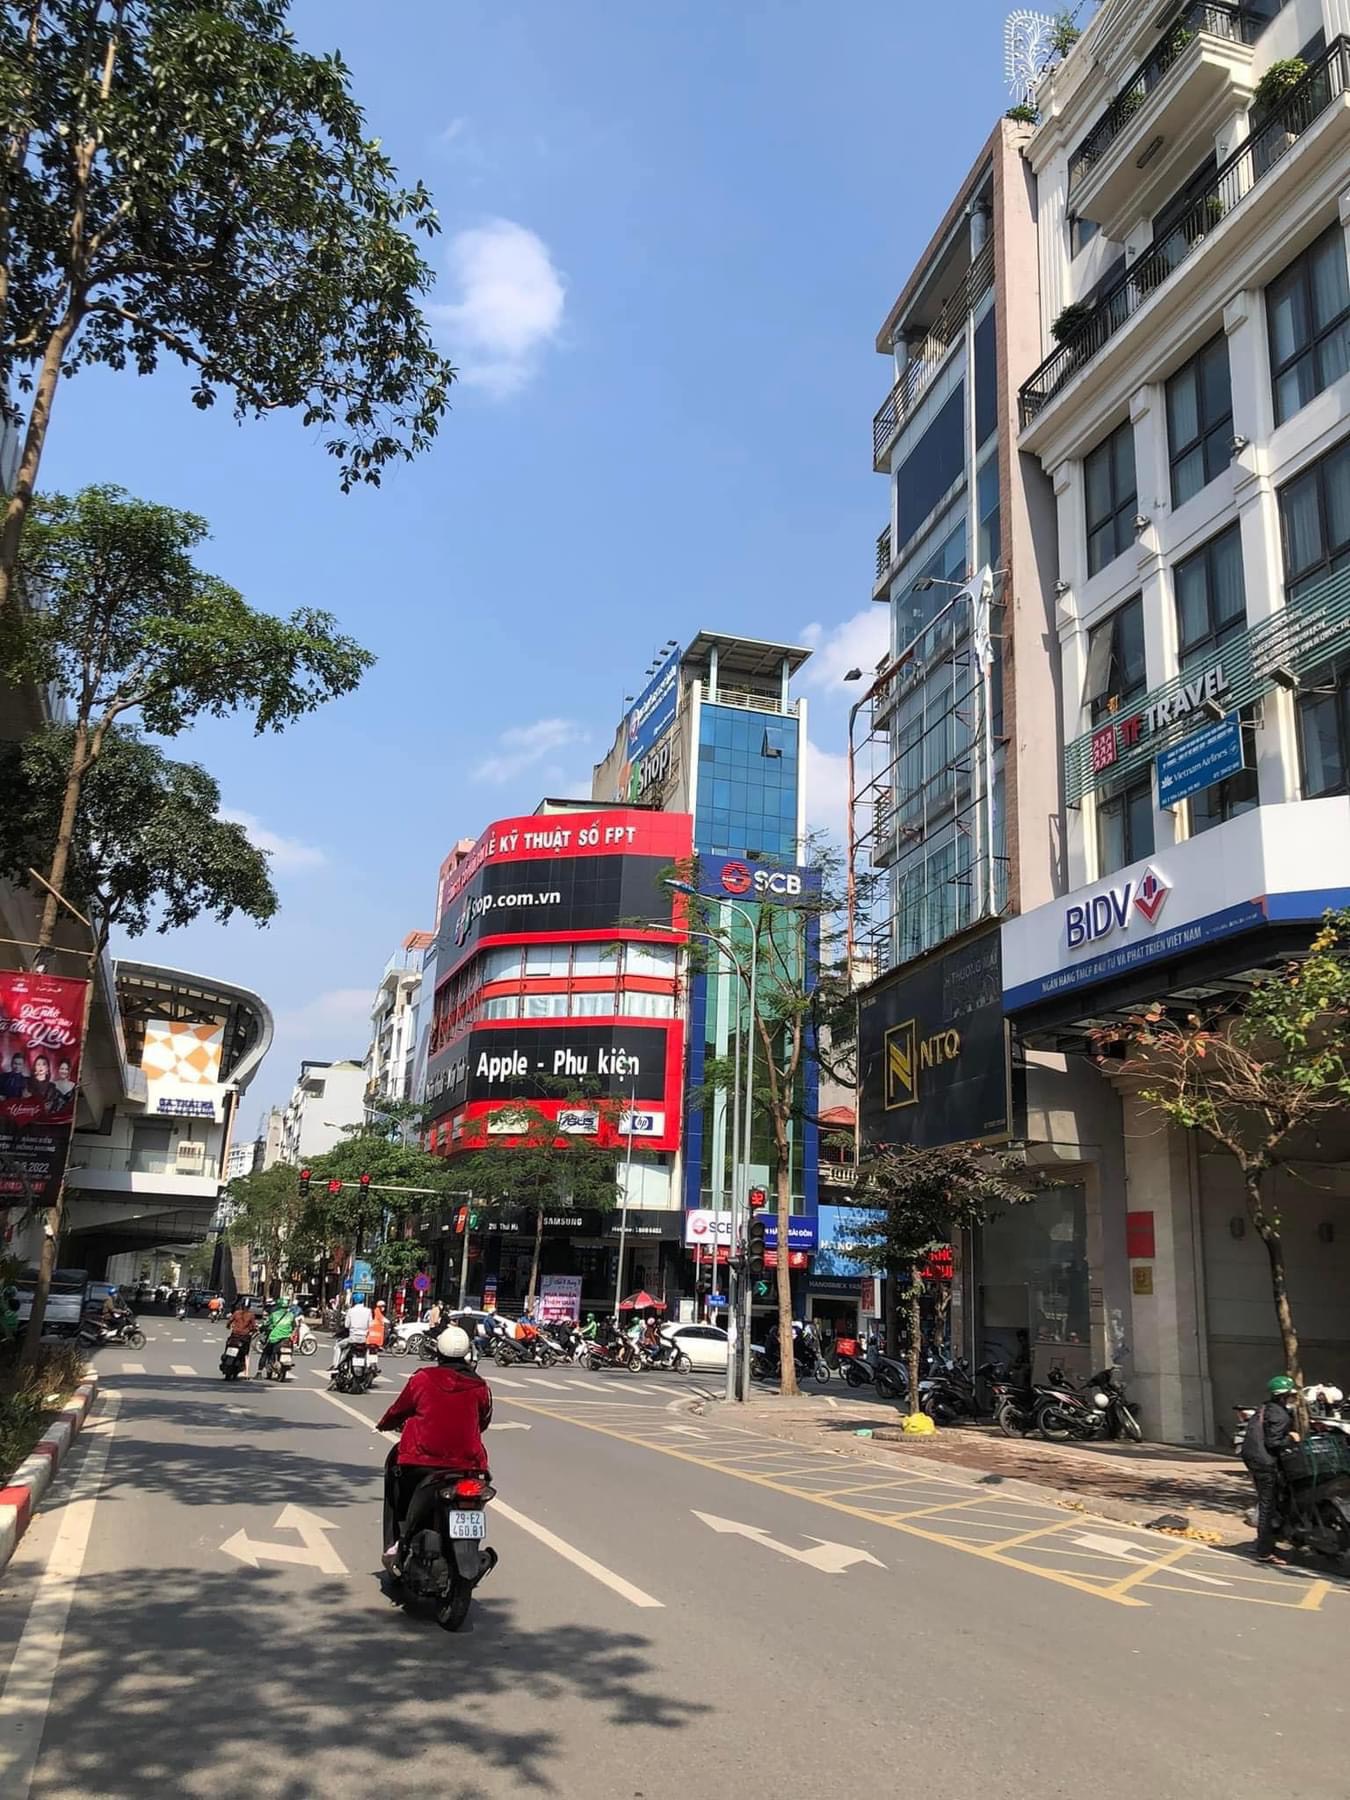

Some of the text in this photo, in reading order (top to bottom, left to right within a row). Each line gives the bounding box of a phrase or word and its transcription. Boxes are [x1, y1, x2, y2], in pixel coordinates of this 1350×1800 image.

[1119, 712, 1143, 747] TF
[1145, 663, 1231, 731] TRAVEL
[1173, 763, 1202, 781] Vietnam
[1202, 748, 1229, 768] Airlines
[500, 829, 519, 853] KỸ
[524, 825, 572, 853] THUẬT
[578, 820, 600, 846] SỐ
[605, 826, 636, 844] FPT
[753, 870, 802, 895] SCB
[1066, 883, 1132, 949] BIDV
[1166, 931, 1182, 949] VIỆT
[1184, 926, 1202, 943] NAM
[476, 1049, 528, 1083] Apple
[553, 1048, 588, 1082] Phụ
[598, 1048, 640, 1082] kiện
[920, 1028, 961, 1071] NTQ
[543, 1217, 583, 1226] SAMSUNG
[455, 1512, 481, 1525] 29-E2
